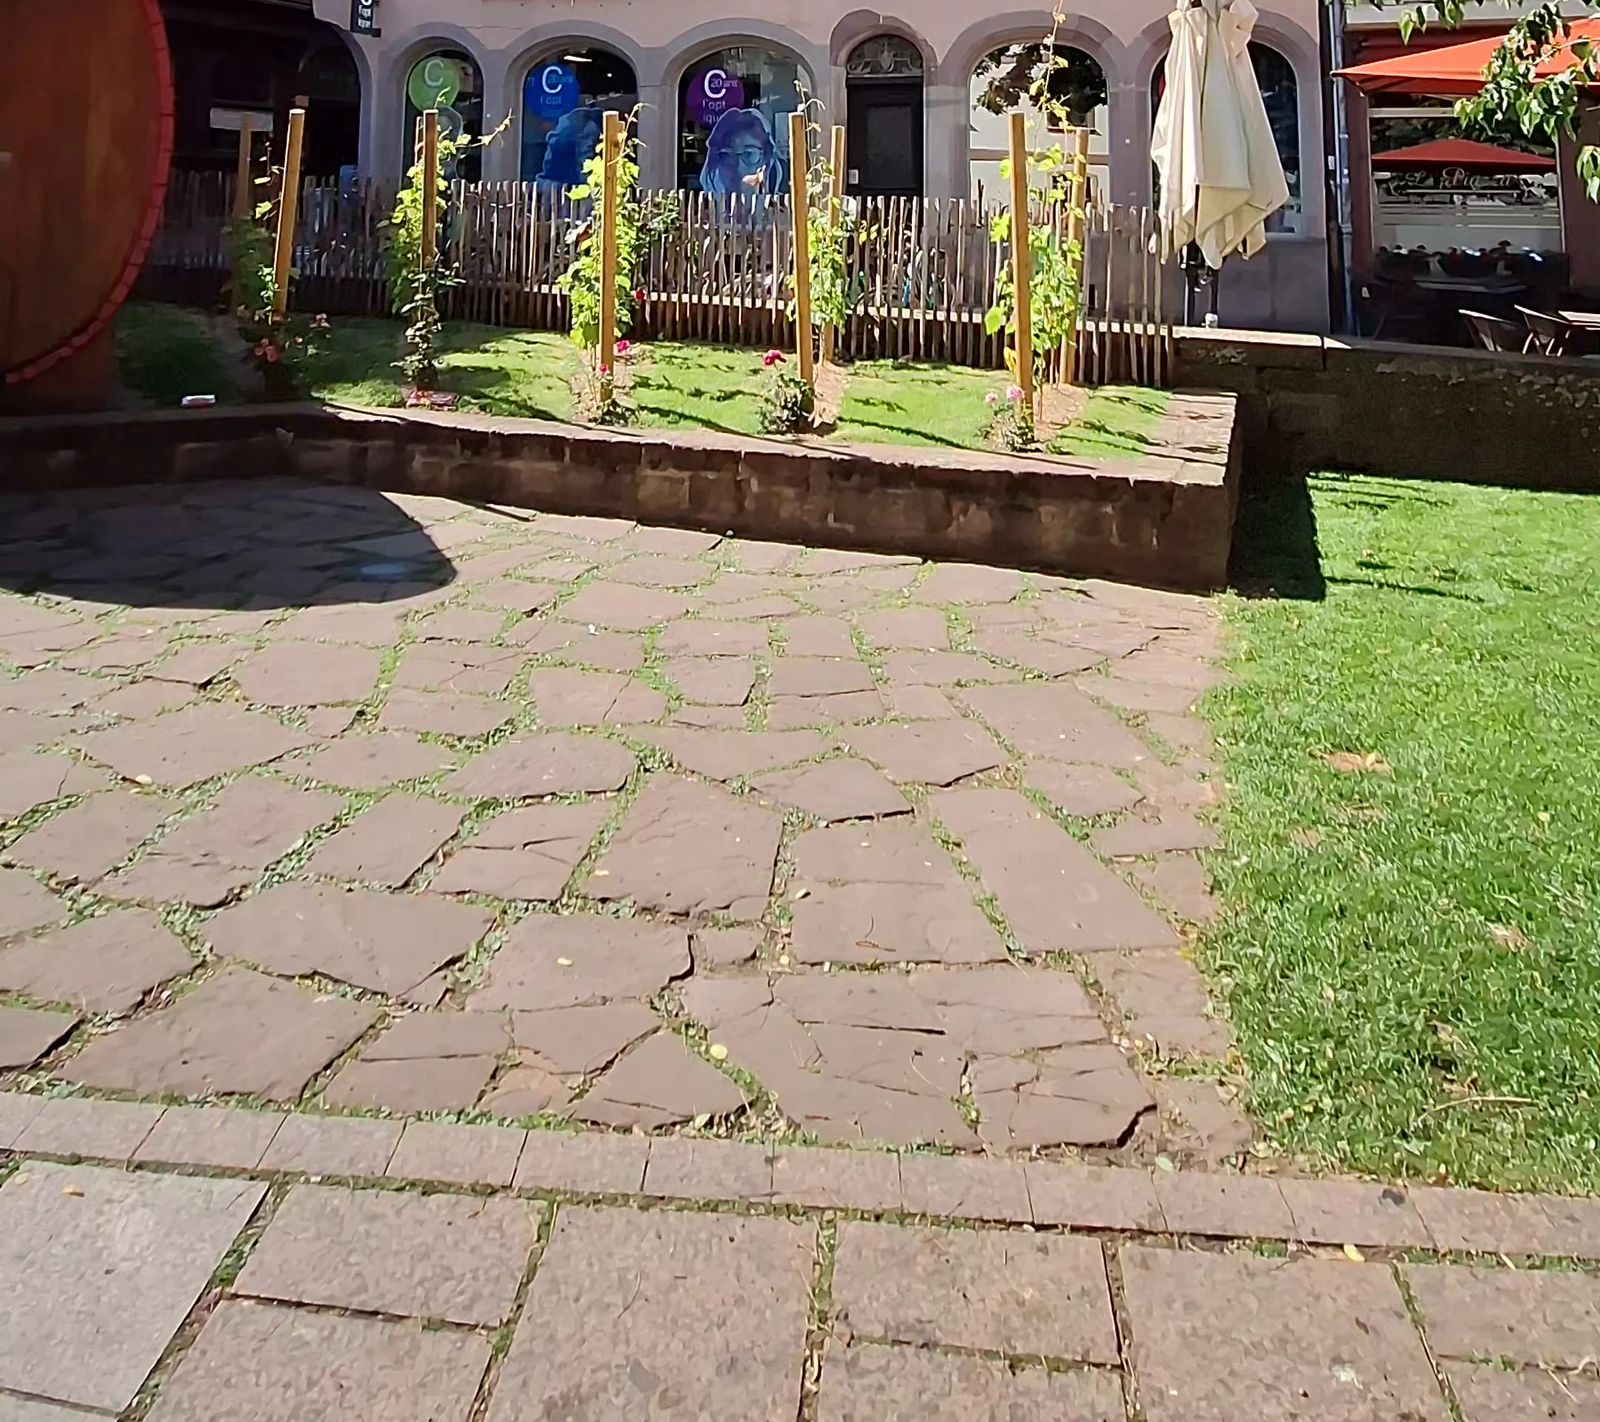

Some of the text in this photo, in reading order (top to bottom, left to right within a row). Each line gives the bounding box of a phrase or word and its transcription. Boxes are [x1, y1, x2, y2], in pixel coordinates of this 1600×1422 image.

[424, 59, 444, 88] C
[541, 65, 563, 94] C
[704, 69, 727, 99] C
